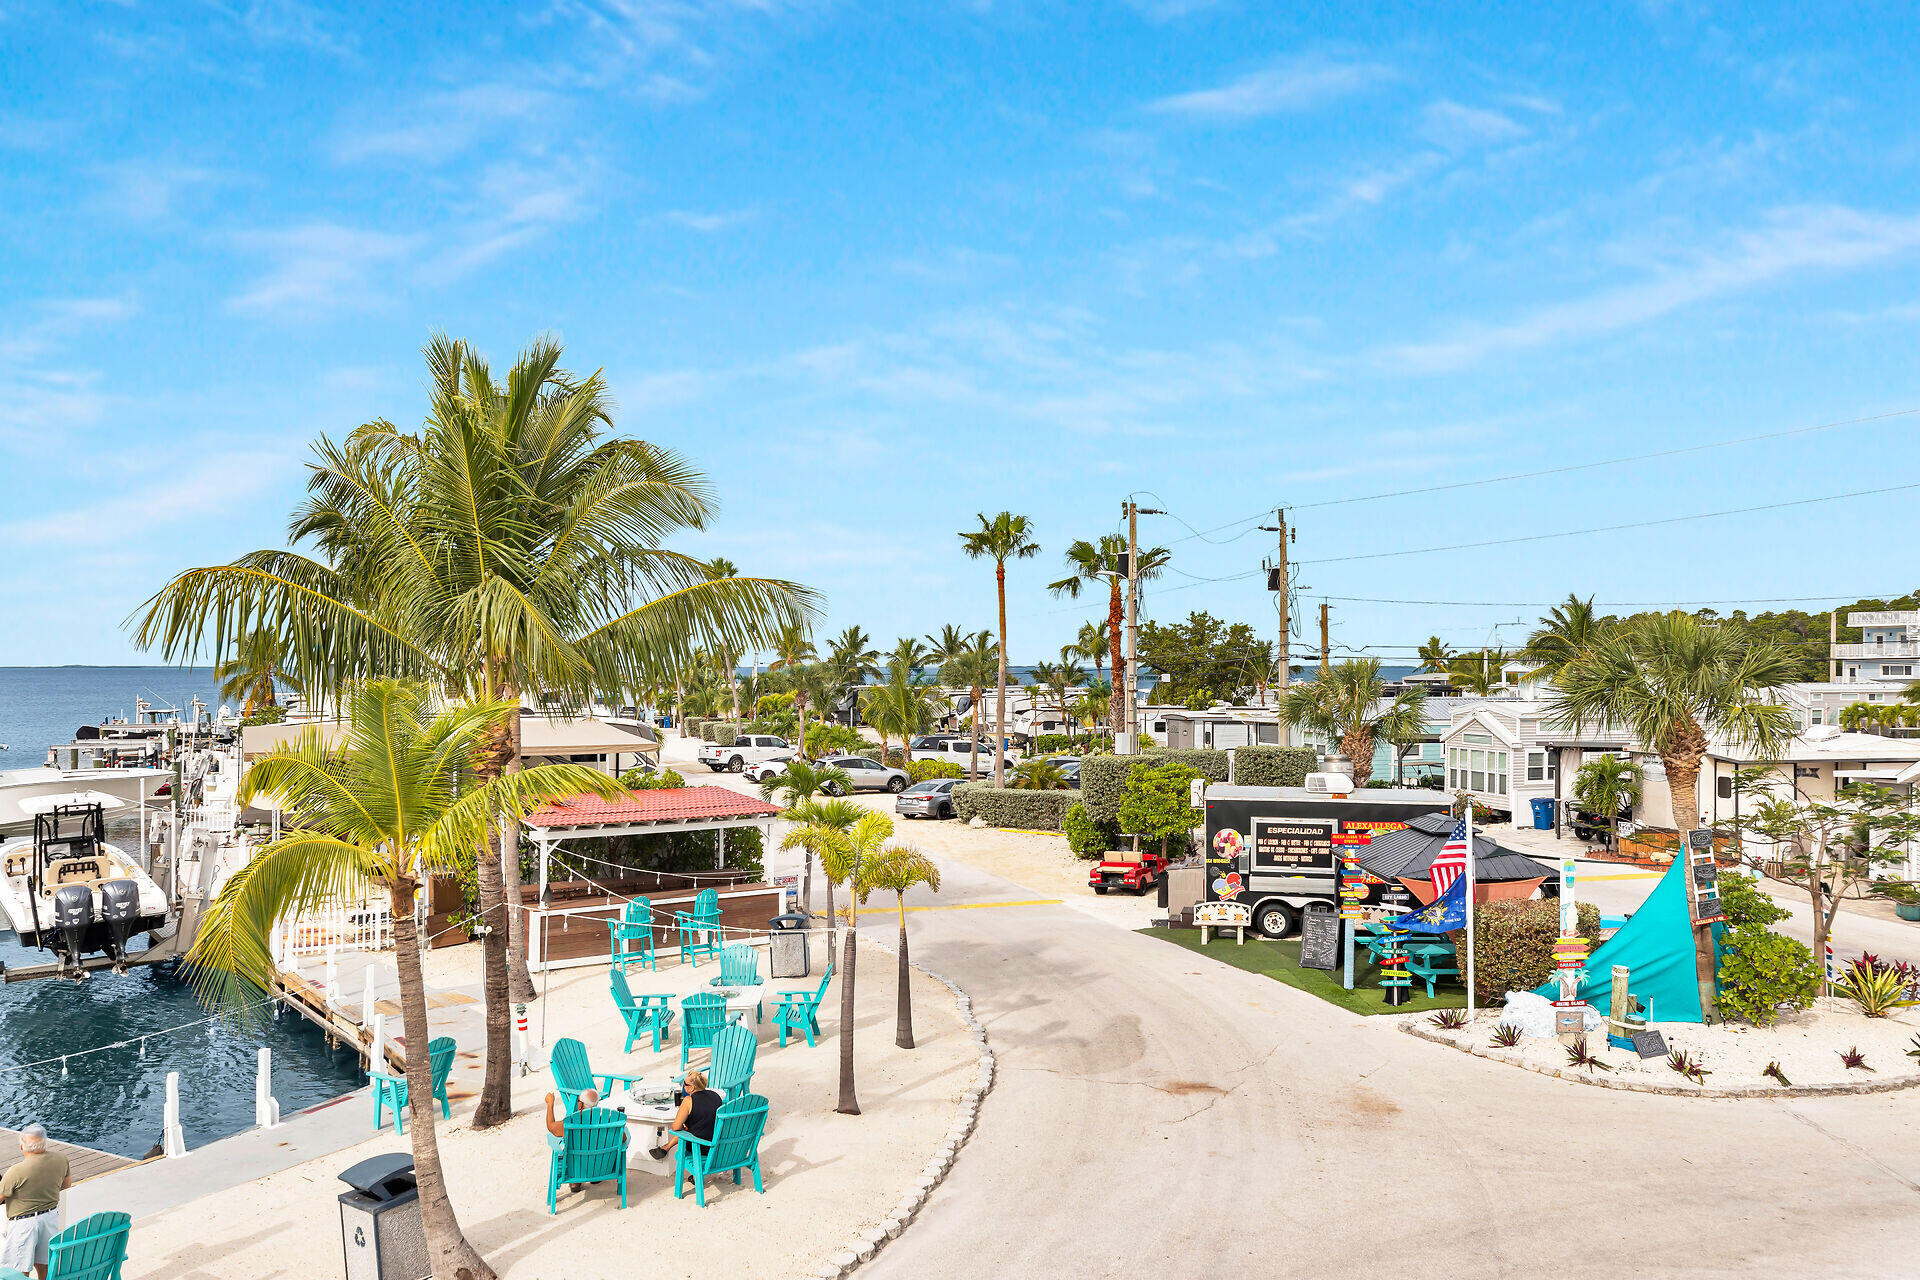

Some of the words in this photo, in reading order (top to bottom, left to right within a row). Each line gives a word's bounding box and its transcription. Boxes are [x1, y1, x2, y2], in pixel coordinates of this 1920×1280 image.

[1345, 822, 1373, 830] ALEXA
[1374, 822, 1403, 830] LLEGA
[1266, 827, 1324, 835] ESPECIALIDAD
